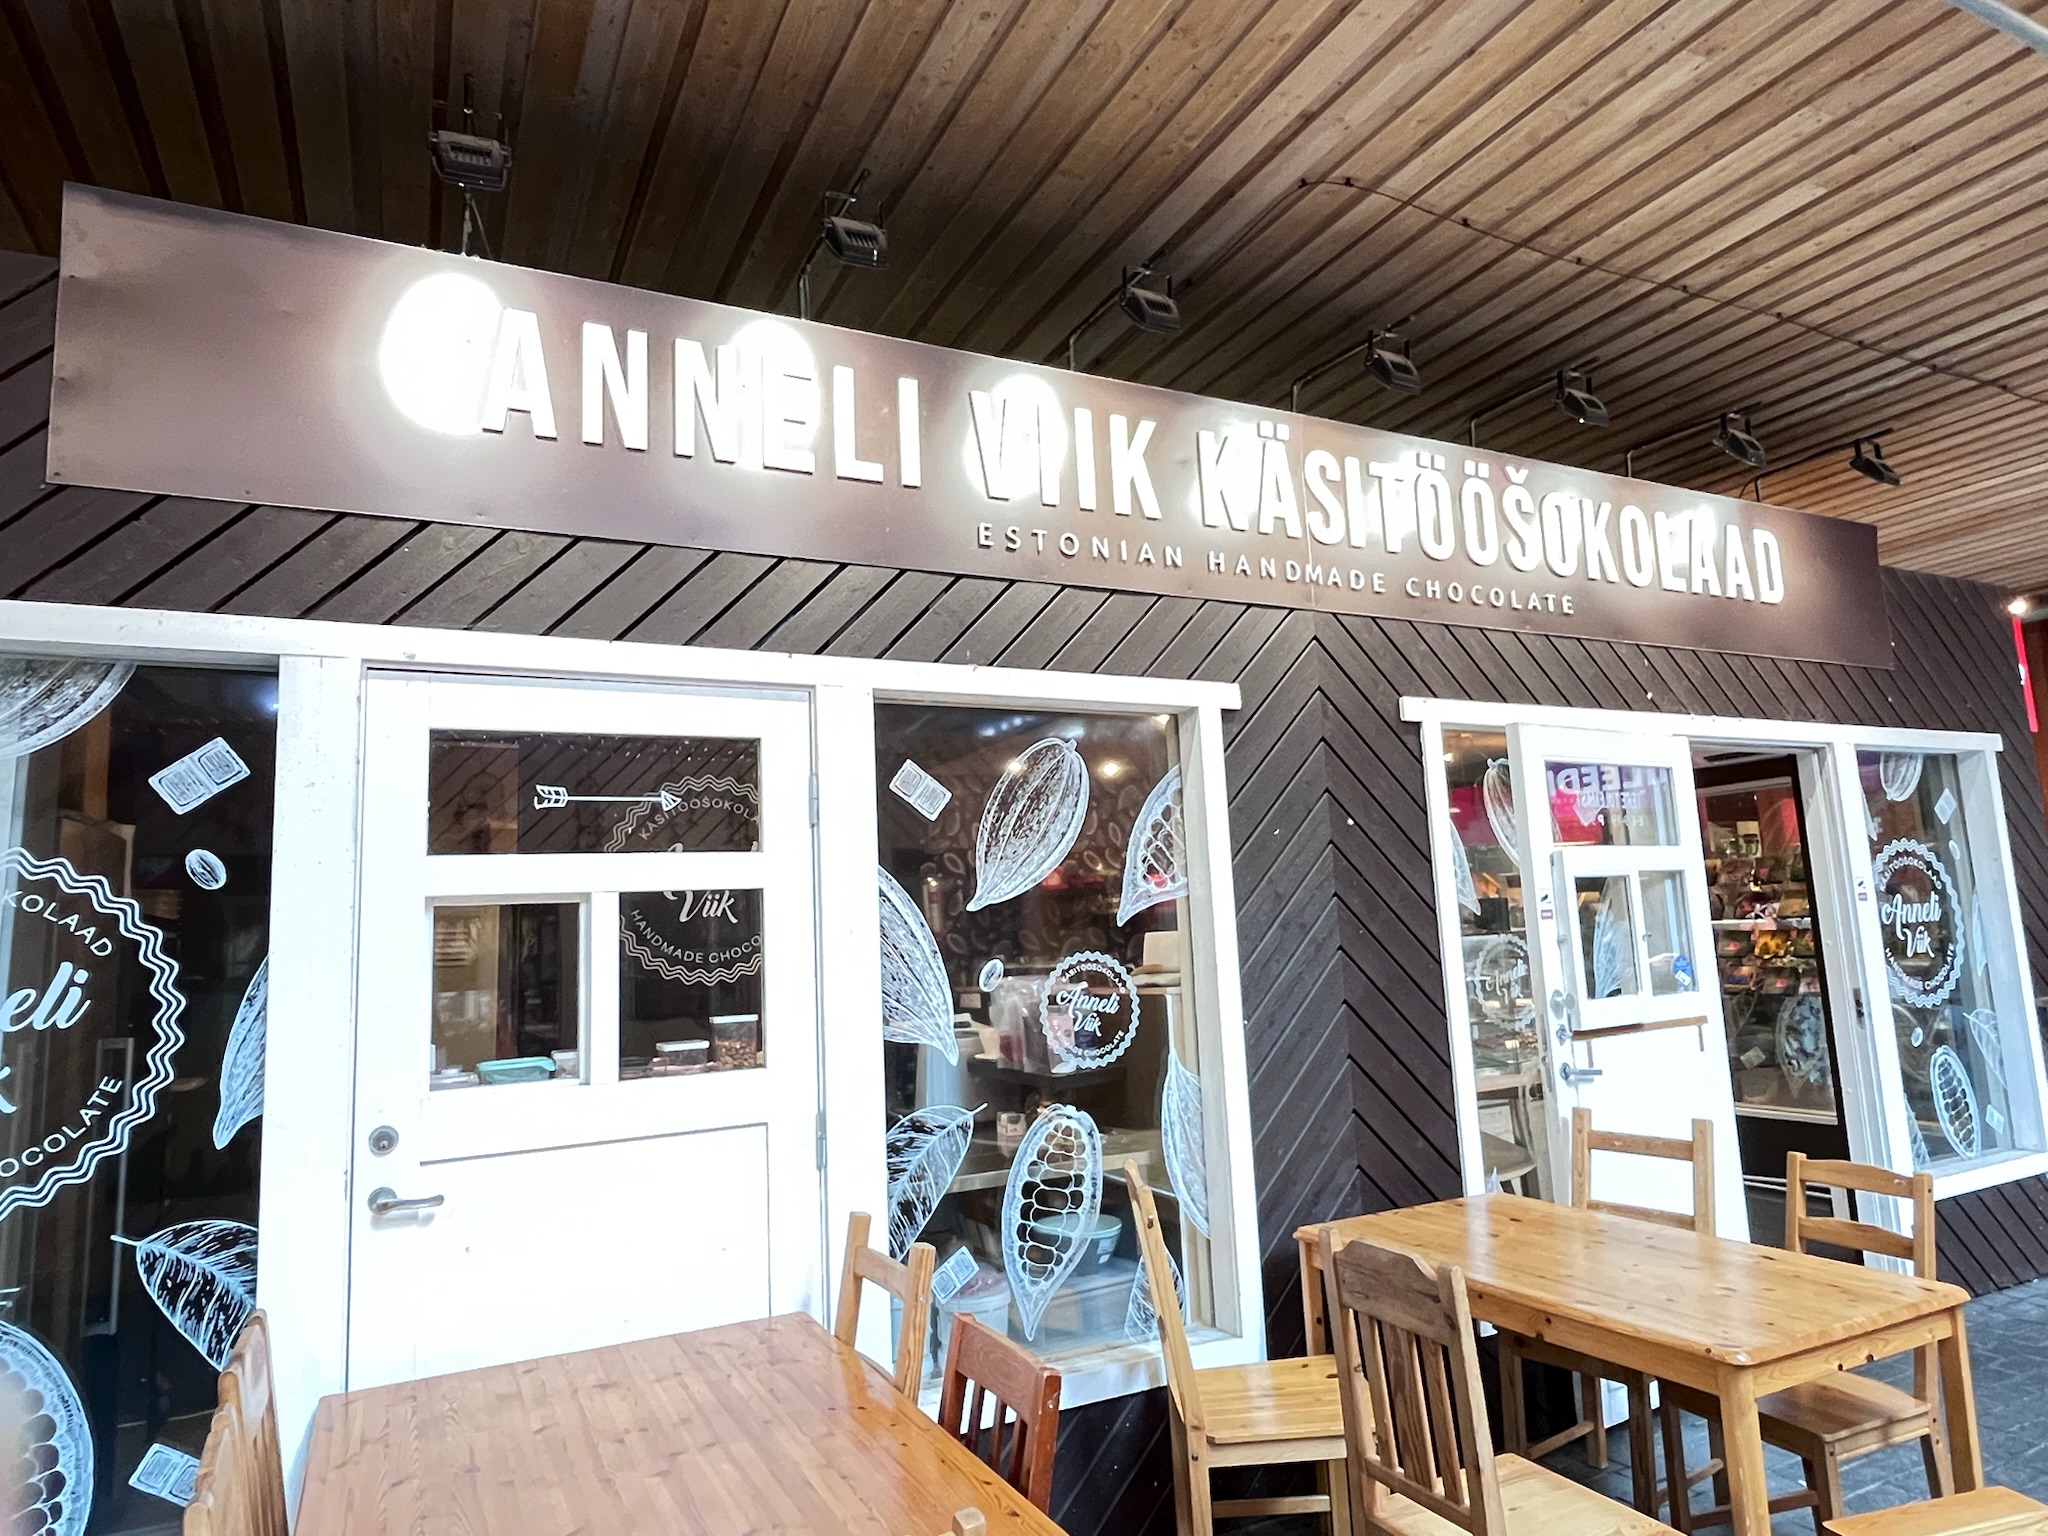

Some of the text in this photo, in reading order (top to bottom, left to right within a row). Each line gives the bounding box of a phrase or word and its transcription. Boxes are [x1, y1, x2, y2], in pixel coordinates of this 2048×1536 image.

[482, 307, 1785, 604] ANNELI VIIK KÄSITÖÖŠOKOLAAD
[977, 522, 1576, 615] ESTONIAN HANDMADE CHOCOLATE
[663, 889, 739, 924] Viik
[1880, 890, 1942, 940] Anneli
[630, 909, 705, 964] HANDMADE
[1056, 980, 1121, 1018] Anneli
[1073, 1010, 1103, 1037] Viik
